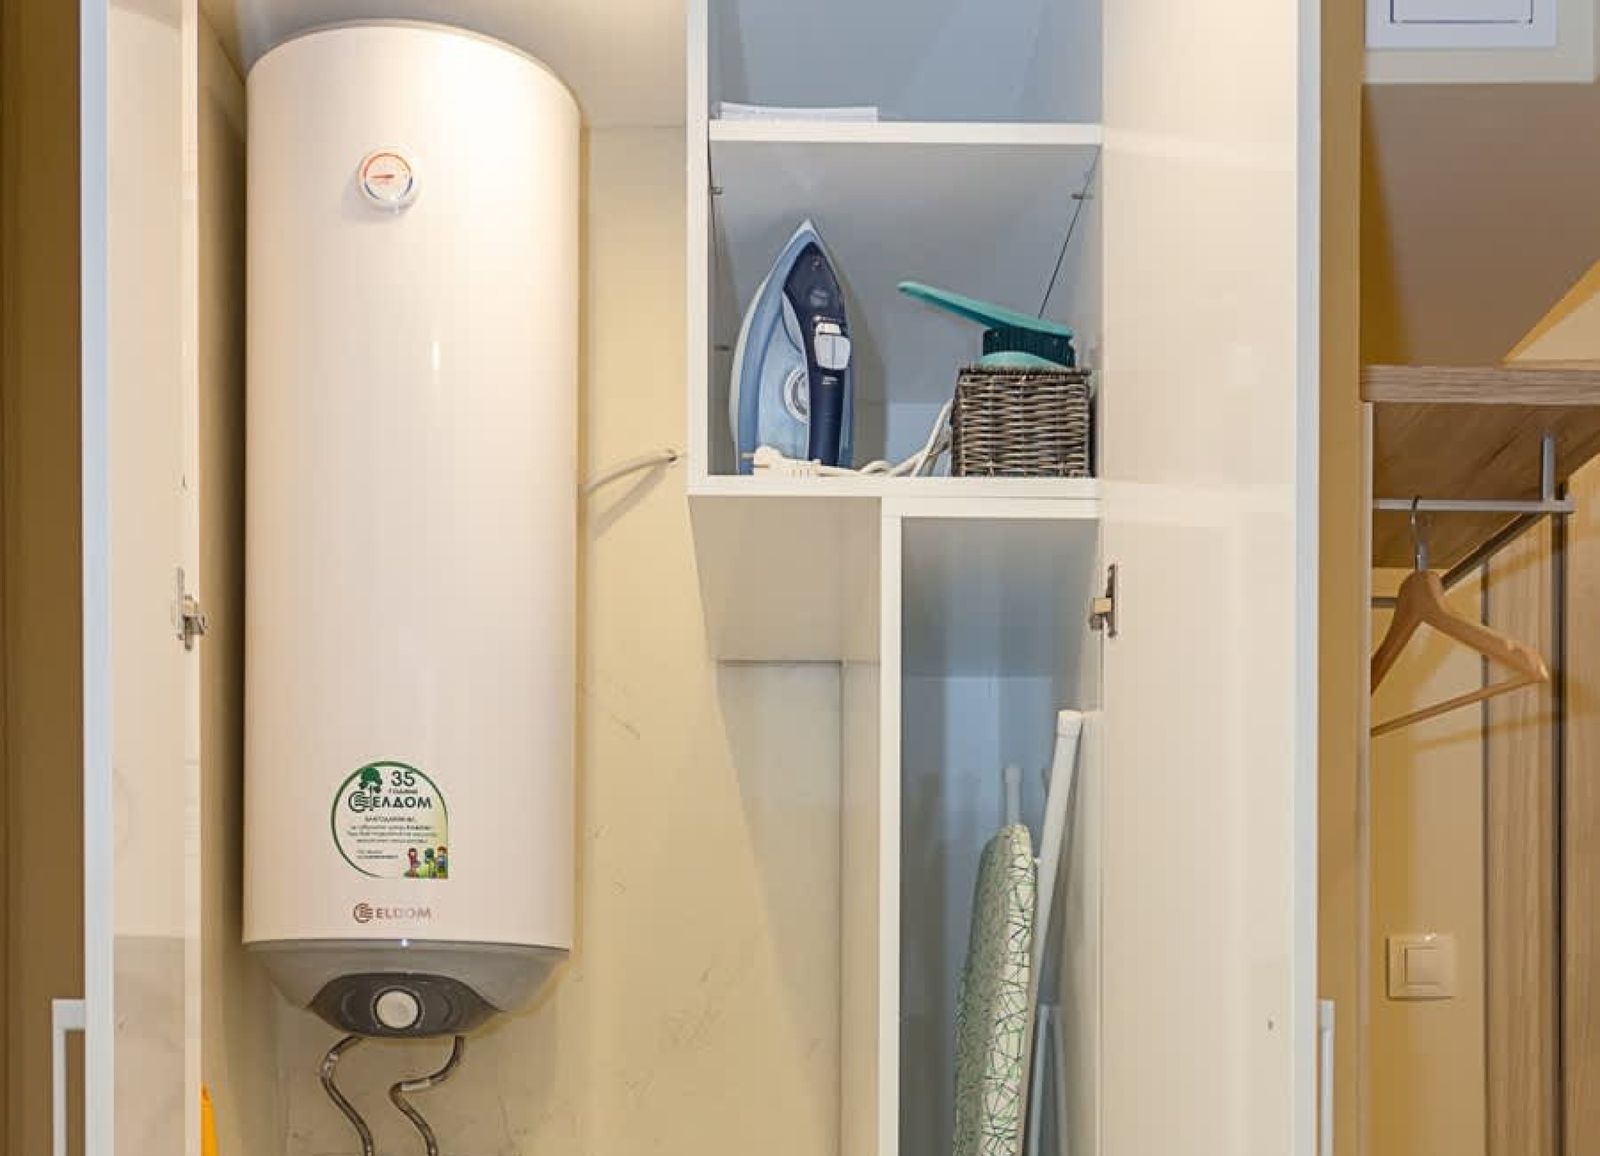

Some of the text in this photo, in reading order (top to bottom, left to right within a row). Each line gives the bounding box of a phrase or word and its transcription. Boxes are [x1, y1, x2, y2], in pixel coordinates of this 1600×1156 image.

[391, 770, 415, 787] 35
[373, 796, 432, 809] ЕЛДОМ
[376, 907, 432, 919] ELDOM
